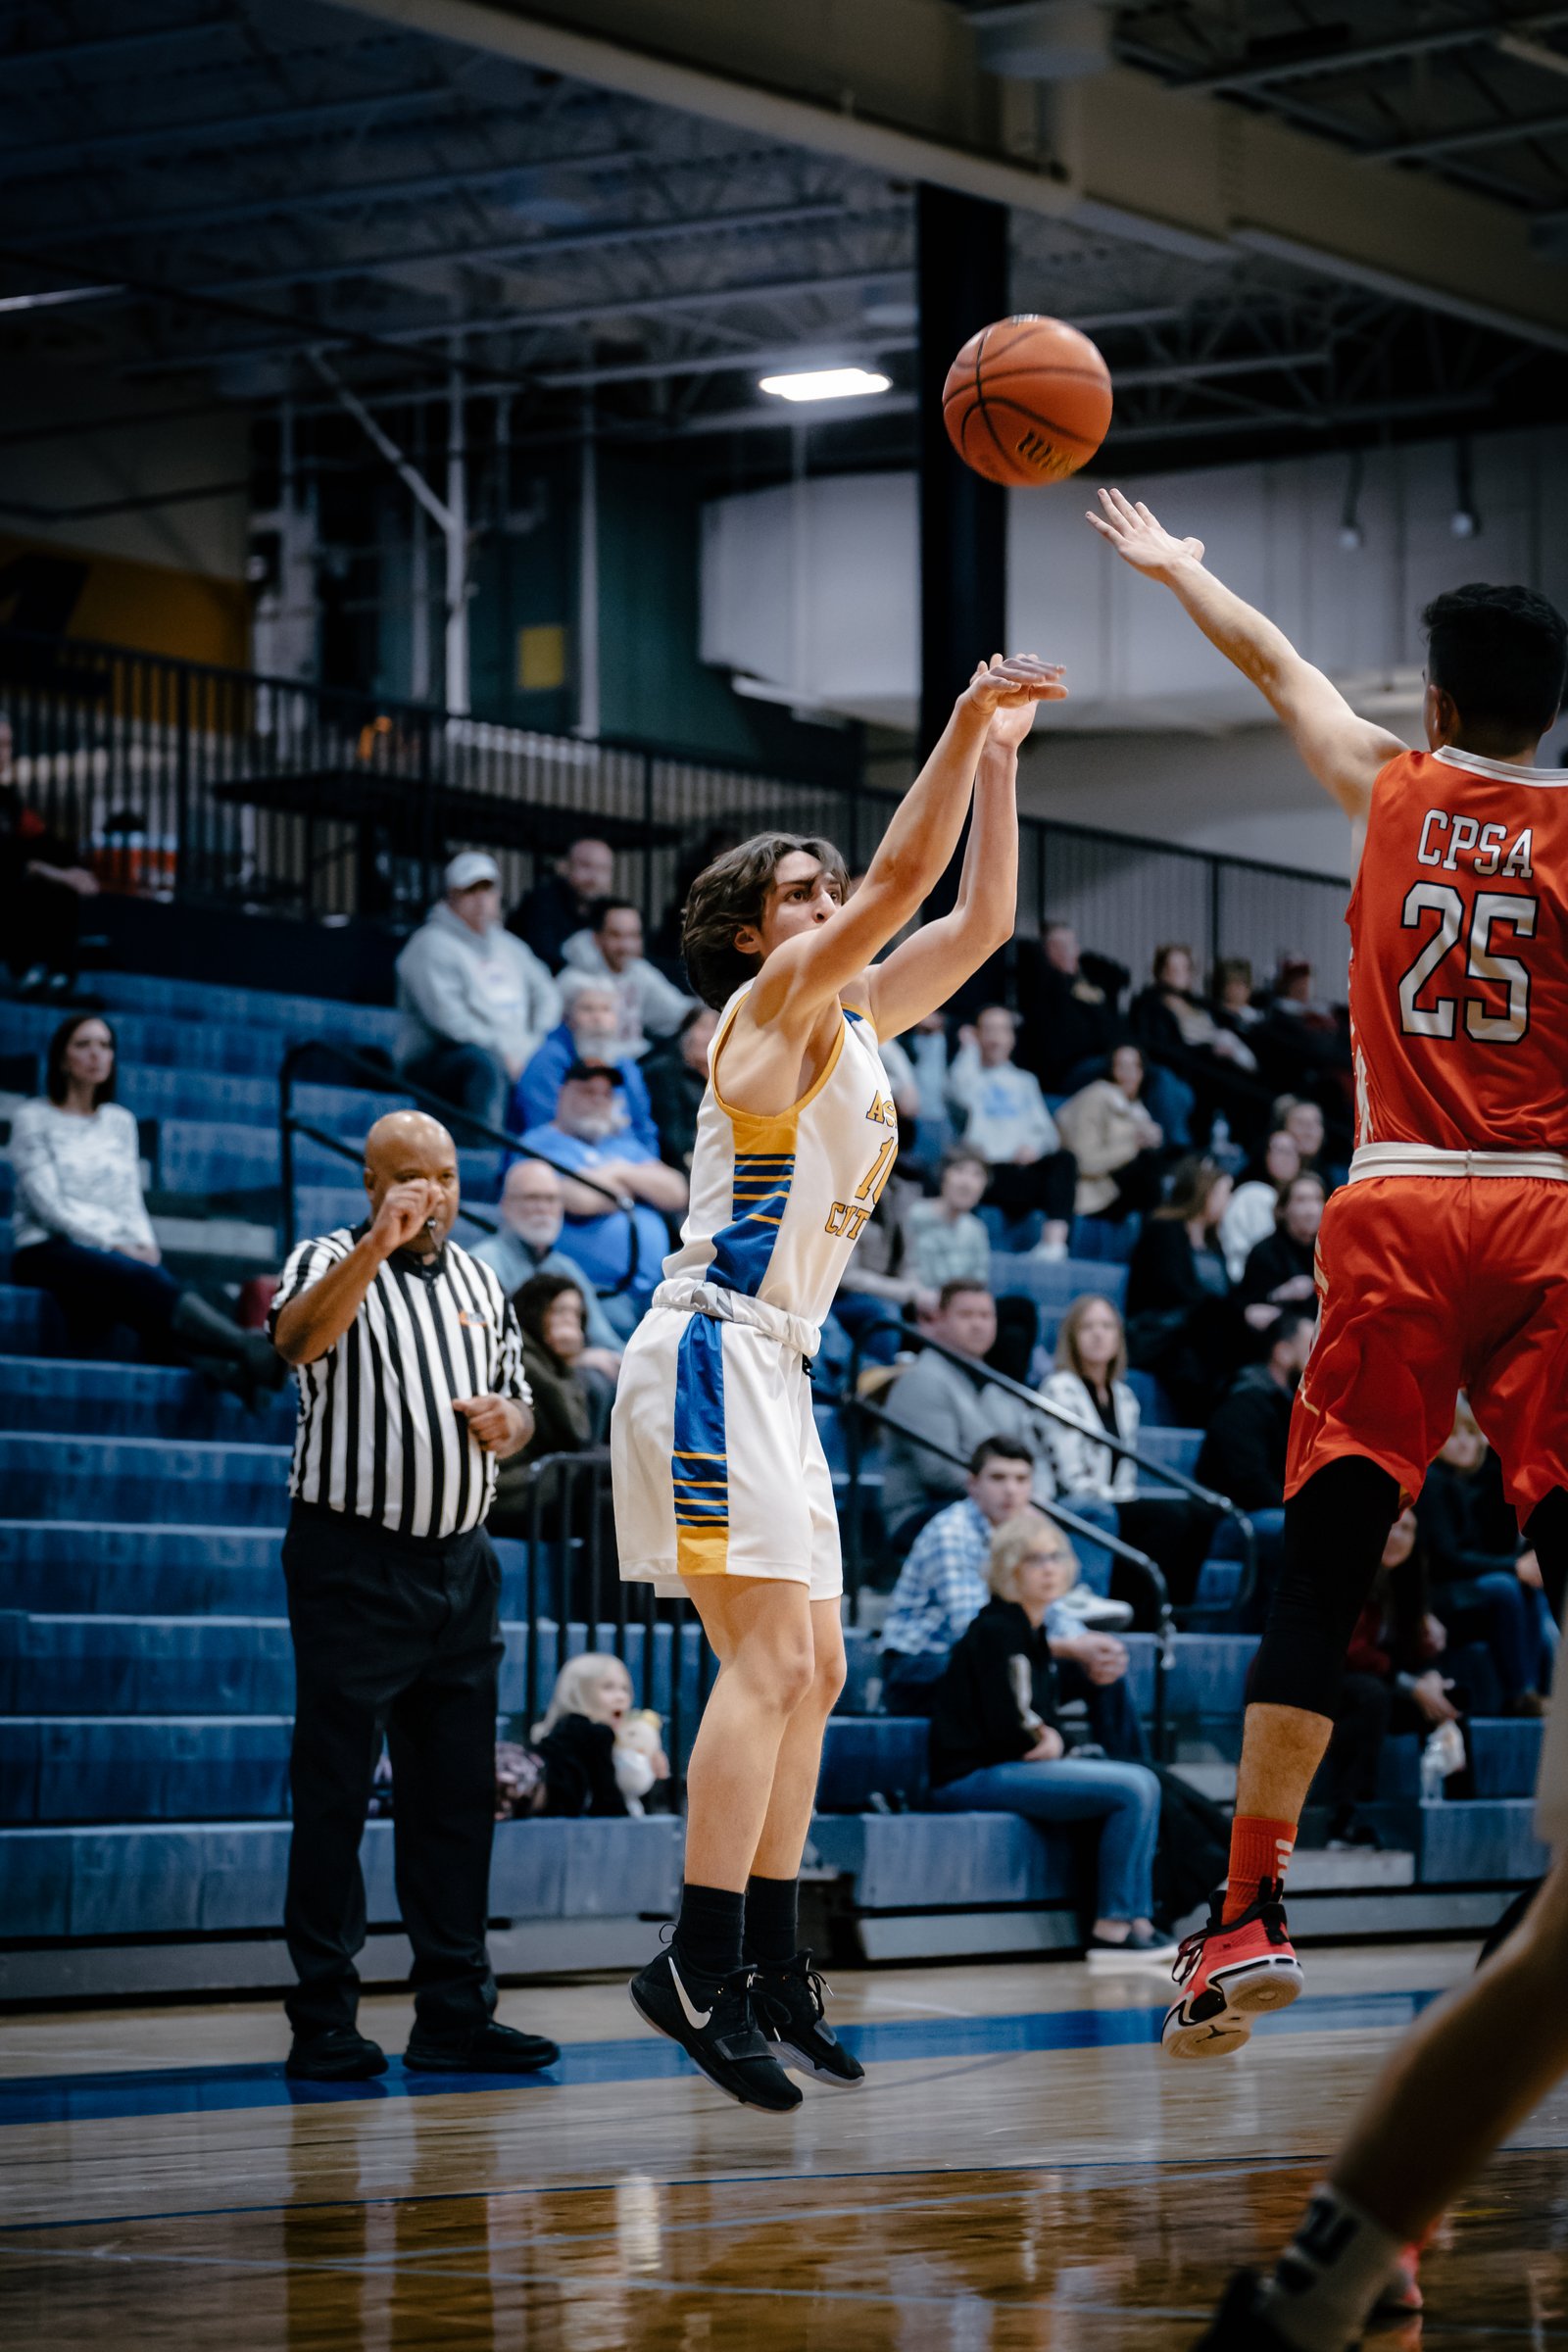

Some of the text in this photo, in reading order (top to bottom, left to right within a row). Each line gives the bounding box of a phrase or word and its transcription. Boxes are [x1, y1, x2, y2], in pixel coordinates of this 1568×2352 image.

[1417, 808, 1534, 879] CPSA
[1398, 880, 1541, 1046] 25
[865, 1090, 898, 1129] AS
